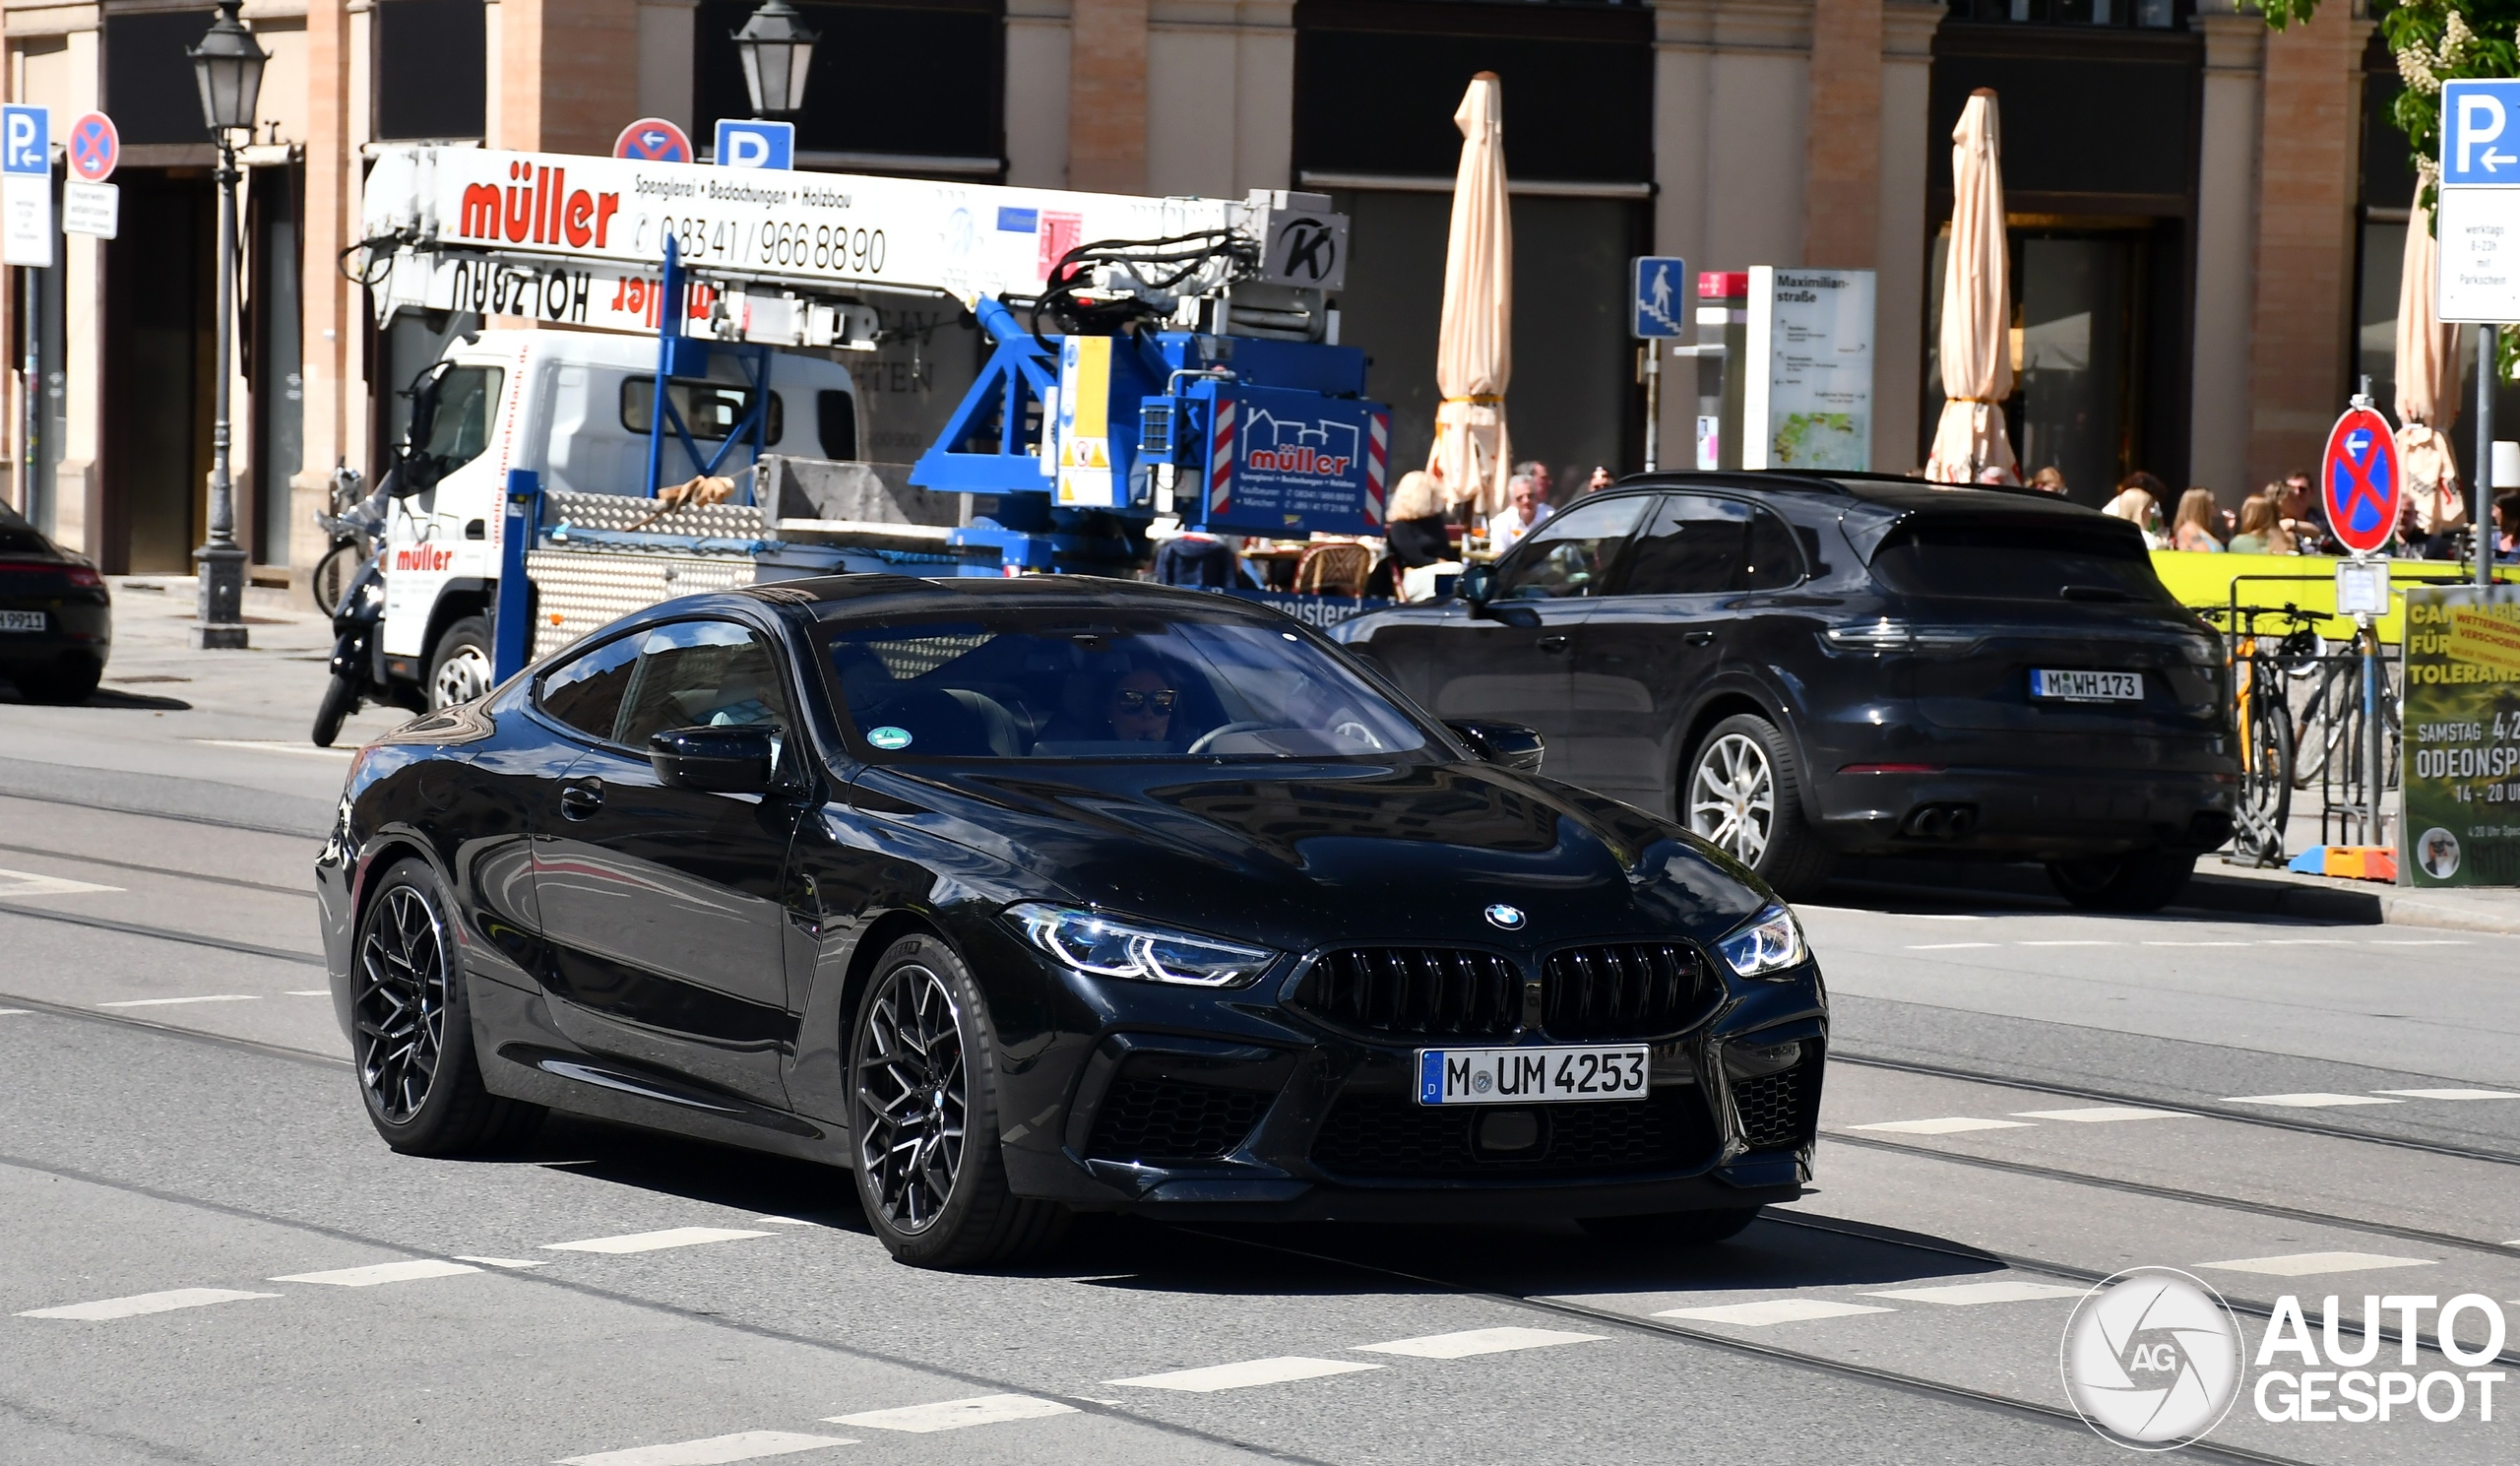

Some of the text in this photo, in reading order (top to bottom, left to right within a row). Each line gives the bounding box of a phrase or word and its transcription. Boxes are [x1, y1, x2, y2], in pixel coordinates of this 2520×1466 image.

[8, 113, 35, 166] P
[728, 131, 770, 167] P
[2456, 95, 2506, 172] P
[460, 160, 619, 248] müller
[635, 173, 851, 209] Spenglerei Bedachungen Holzbau
[1777, 275, 1850, 289] Maximilian-
[1777, 290, 1817, 303] straße
[611, 276, 716, 329] mller
[1249, 444, 1351, 477] müller
[397, 542, 453, 571] müller
[8, 611, 42, 628] 9911
[1262, 594, 1371, 628] eisterd
[2410, 603, 2520, 624] CANABIS
[2410, 628, 2451, 655] FÜR
[2048, 672, 2135, 696] M WH 173
[2418, 723, 2482, 742] SAMSTAG
[2417, 746, 2520, 779] ODEONSP
[2456, 784, 2472, 803] 14
[2488, 784, 2503, 802] 20
[1427, 1083, 1436, 1095] D
[1447, 1052, 1644, 1097] M UM 4253
